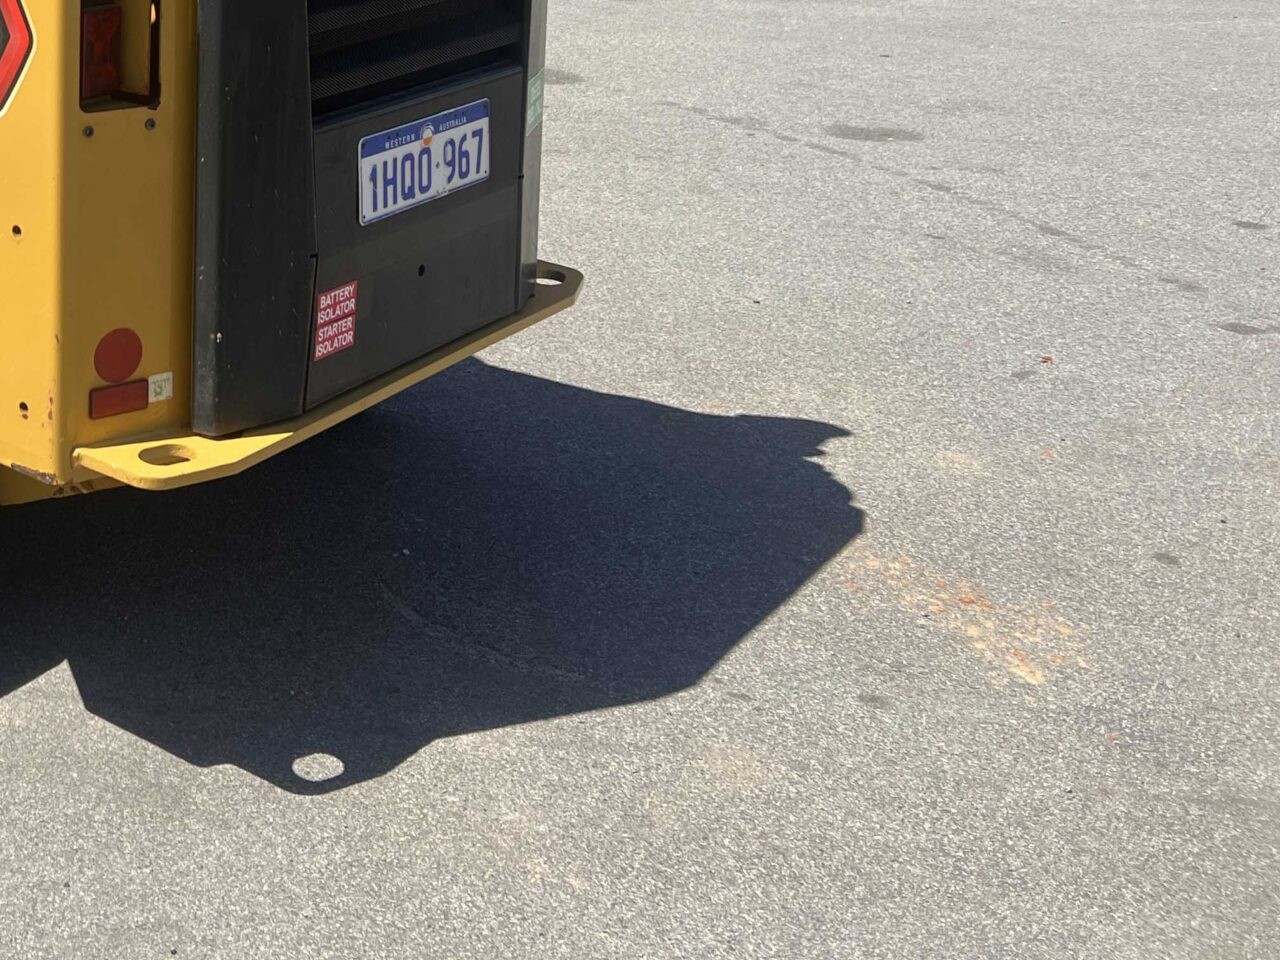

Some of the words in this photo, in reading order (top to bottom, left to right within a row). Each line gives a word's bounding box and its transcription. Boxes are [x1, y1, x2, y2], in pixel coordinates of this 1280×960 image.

[385, 133, 416, 150] WESTERN
[439, 116, 467, 132] AUSTRALIA
[320, 284, 355, 308] BATTERY
[317, 298, 356, 324] ISOLATOR
[318, 317, 352, 342] STARTER
[315, 331, 353, 358] ISOLATOR
